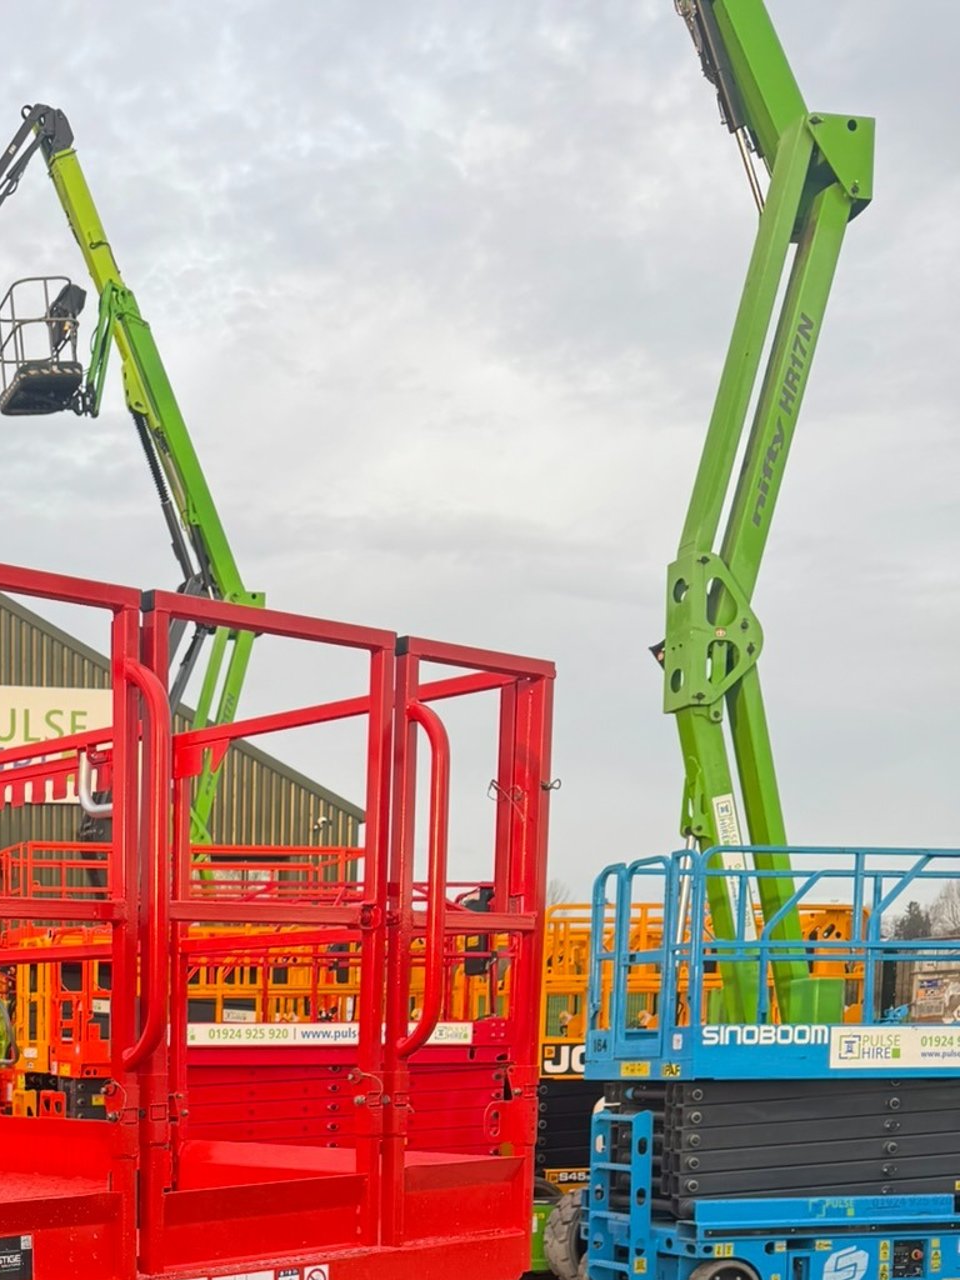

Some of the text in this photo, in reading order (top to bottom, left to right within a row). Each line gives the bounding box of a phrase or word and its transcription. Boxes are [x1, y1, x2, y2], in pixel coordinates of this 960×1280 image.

[752, 311, 815, 528] nifty HR17N
[208, 1027, 358, 1041] 01924 925 920 www.puls
[862, 1034, 901, 1047] PULSE
[920, 1036, 954, 1047] 01924
[543, 1045, 585, 1073] JC
[862, 1047, 891, 1059] HIRE
